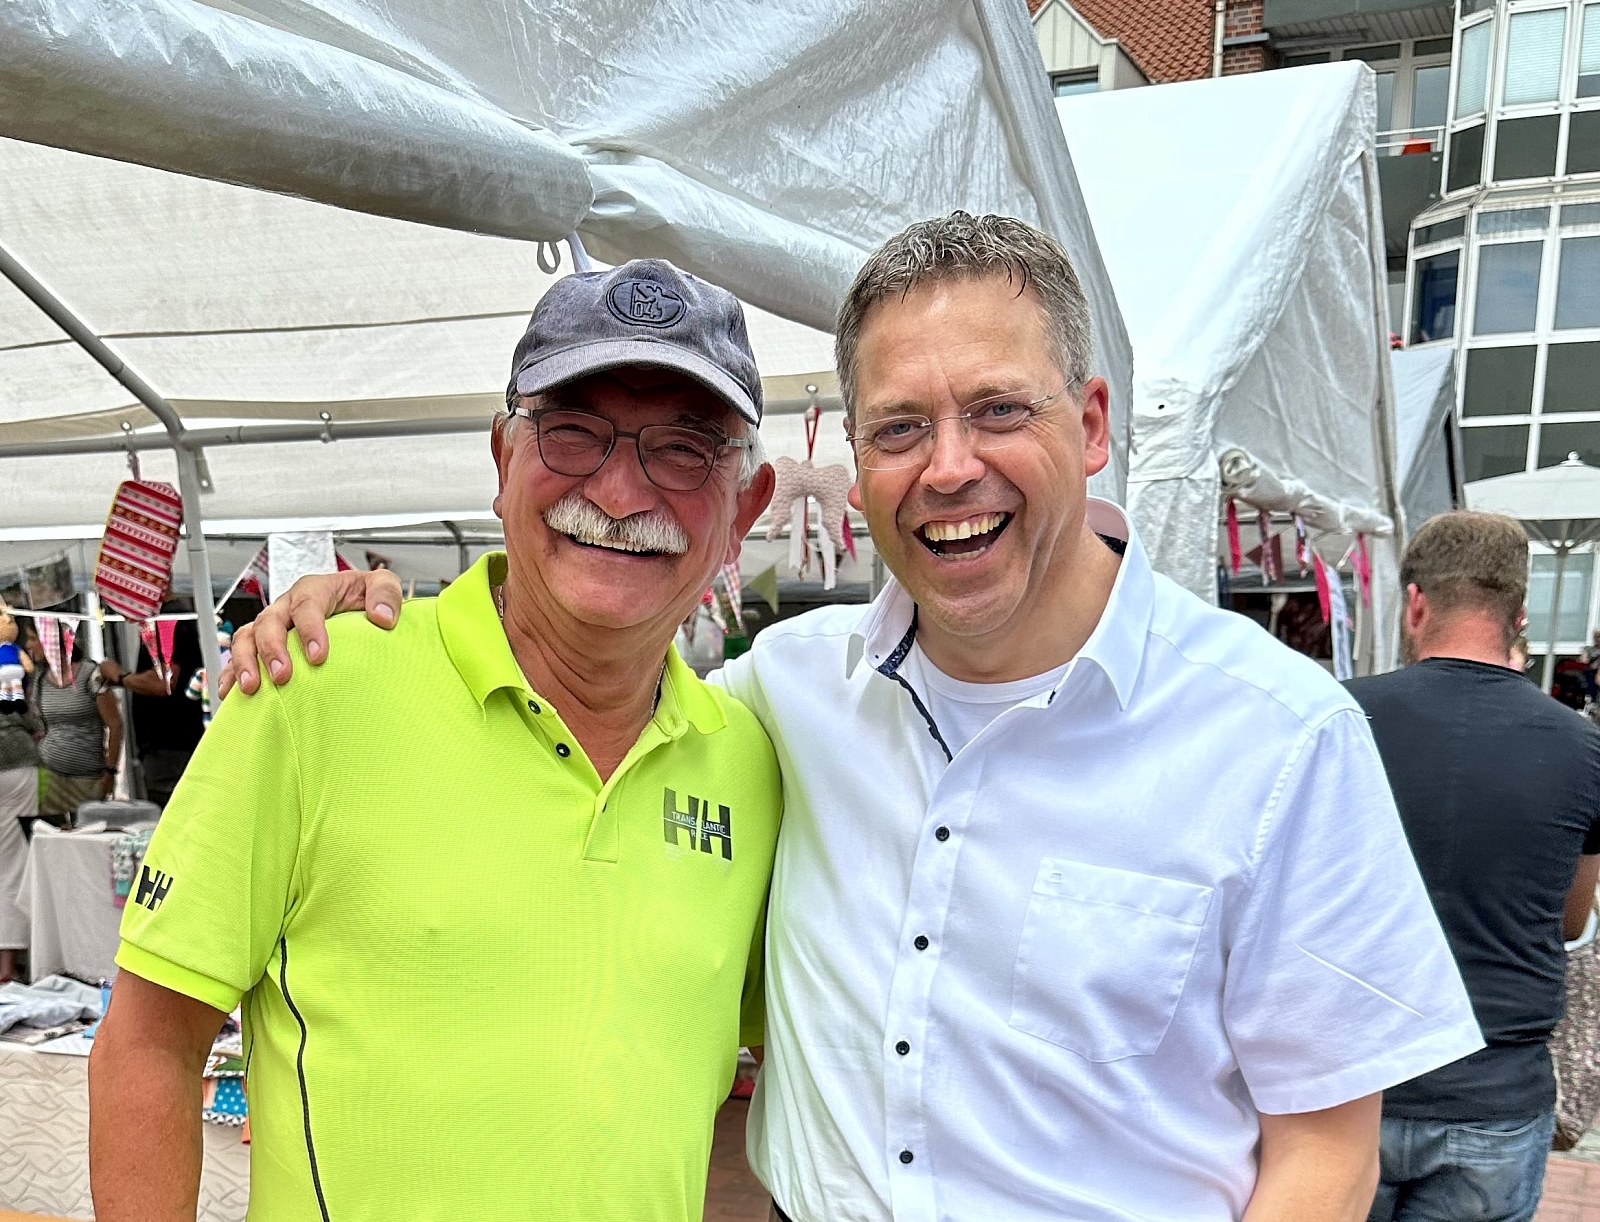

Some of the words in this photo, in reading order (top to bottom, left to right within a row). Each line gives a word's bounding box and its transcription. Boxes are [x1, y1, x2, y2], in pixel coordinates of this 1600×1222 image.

[663, 786, 732, 861] HH
[672, 811, 726, 834] TRANSLANTIC
[135, 865, 174, 912] HH
